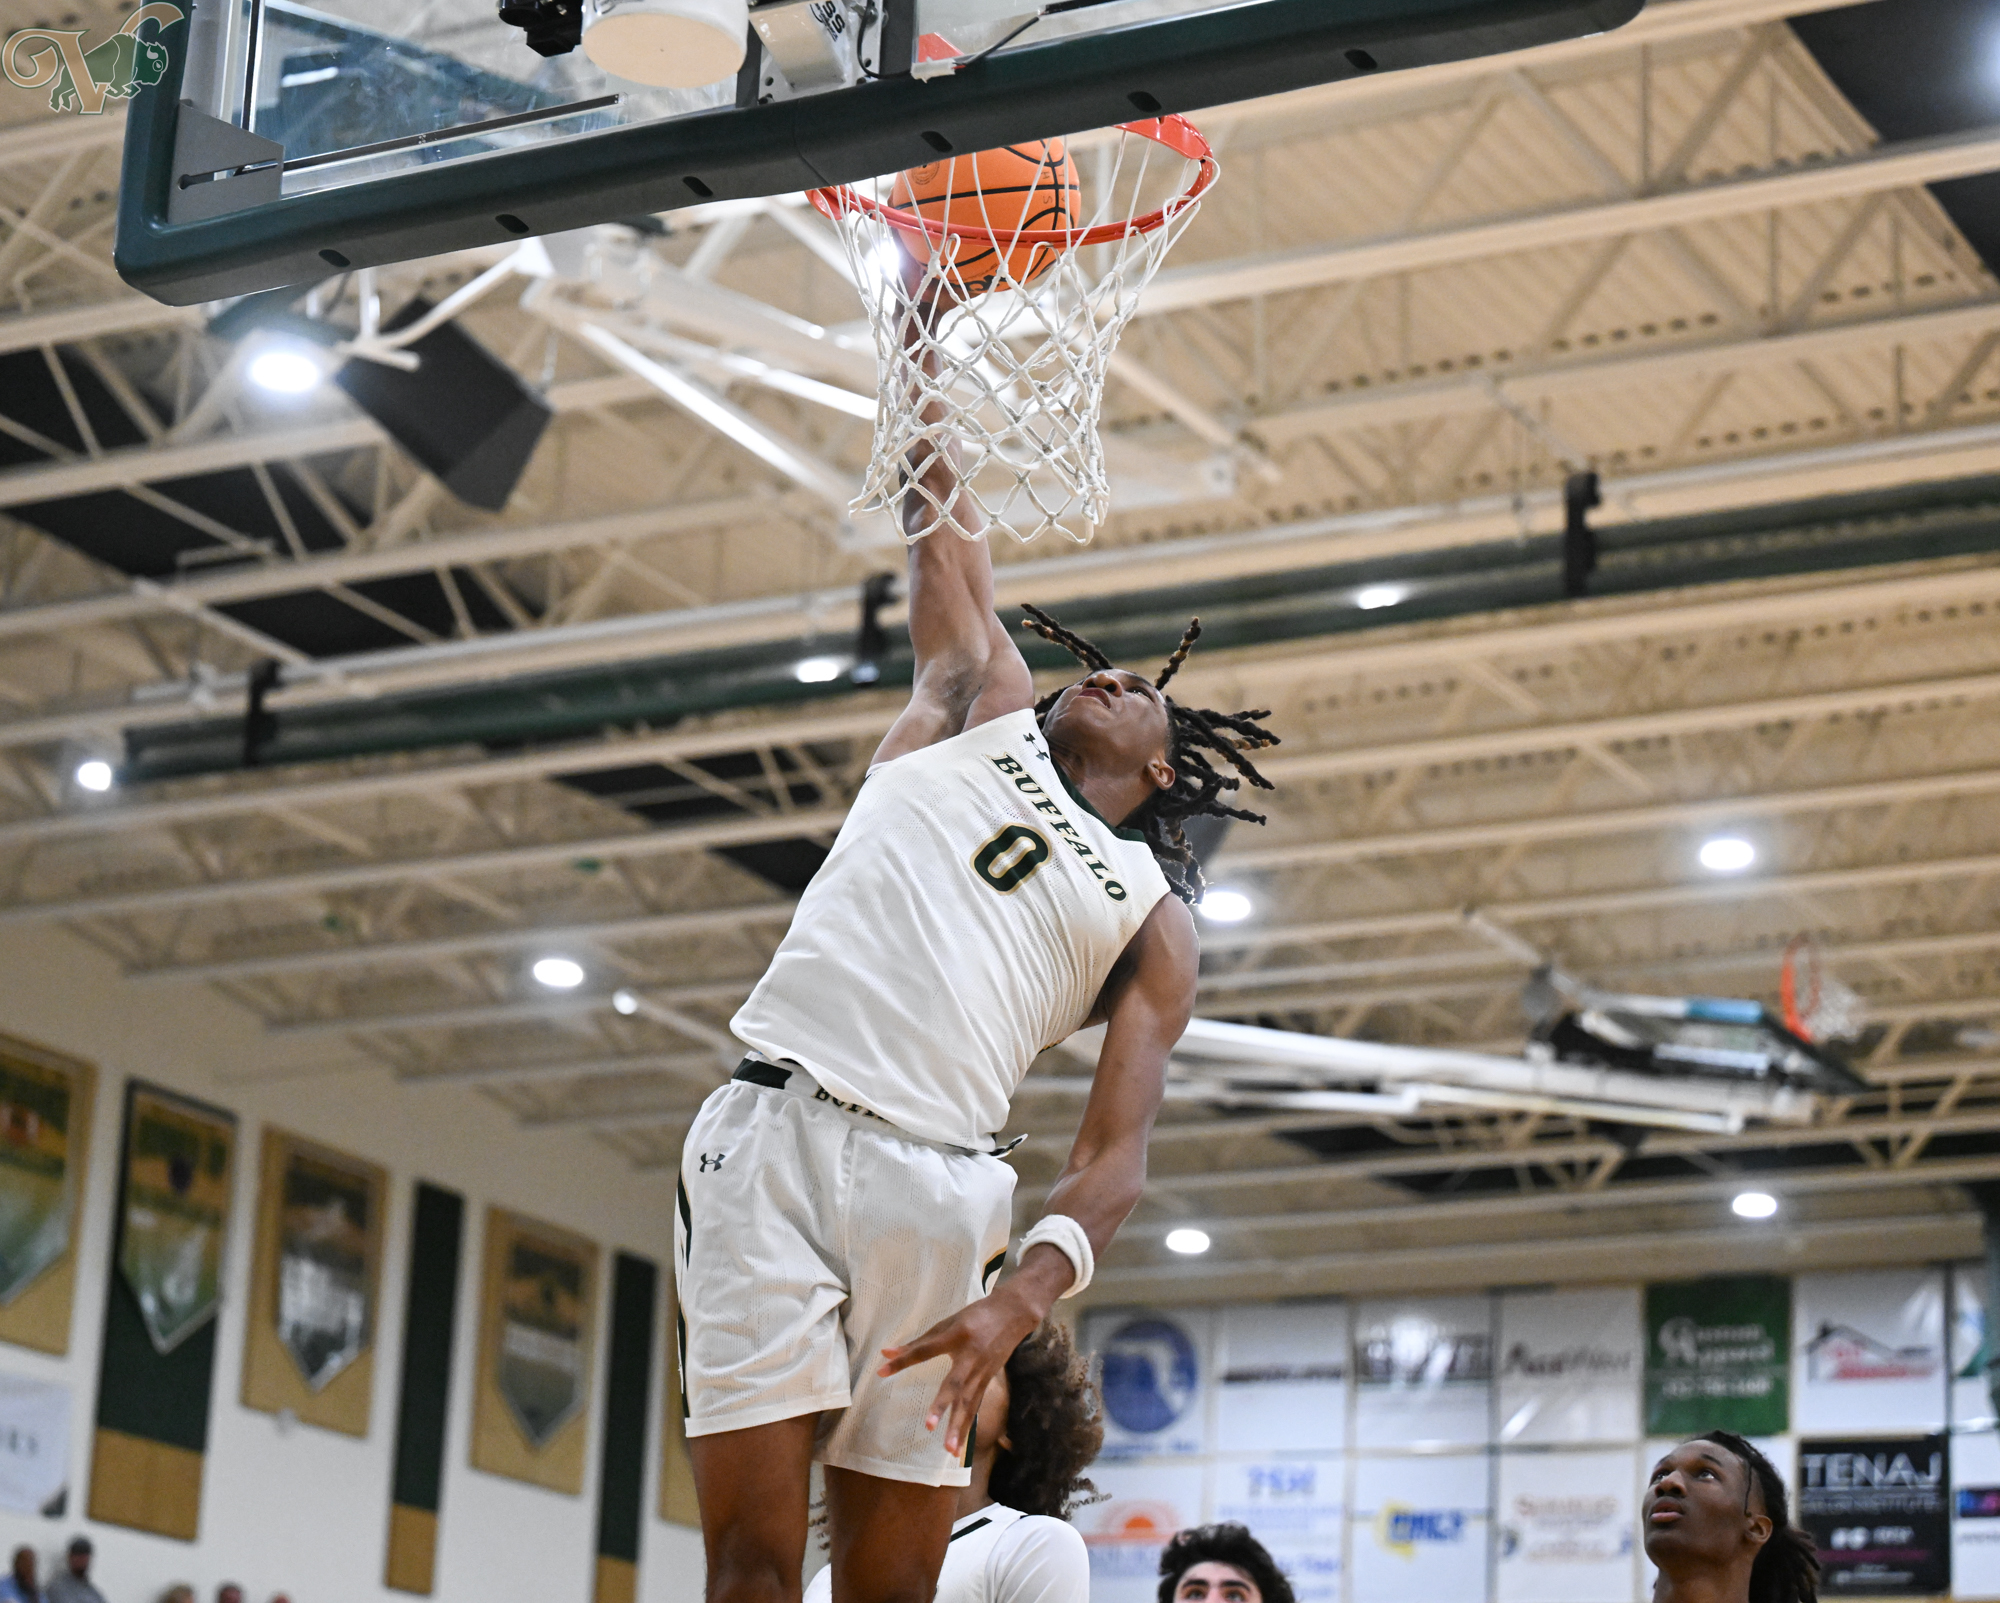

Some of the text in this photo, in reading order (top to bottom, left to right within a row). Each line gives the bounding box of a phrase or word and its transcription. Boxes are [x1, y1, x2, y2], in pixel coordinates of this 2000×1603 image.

[970, 822, 1052, 896] 0
[985, 752, 1130, 903] BUFFALO
[1800, 1452, 1943, 1488] TENAJ
